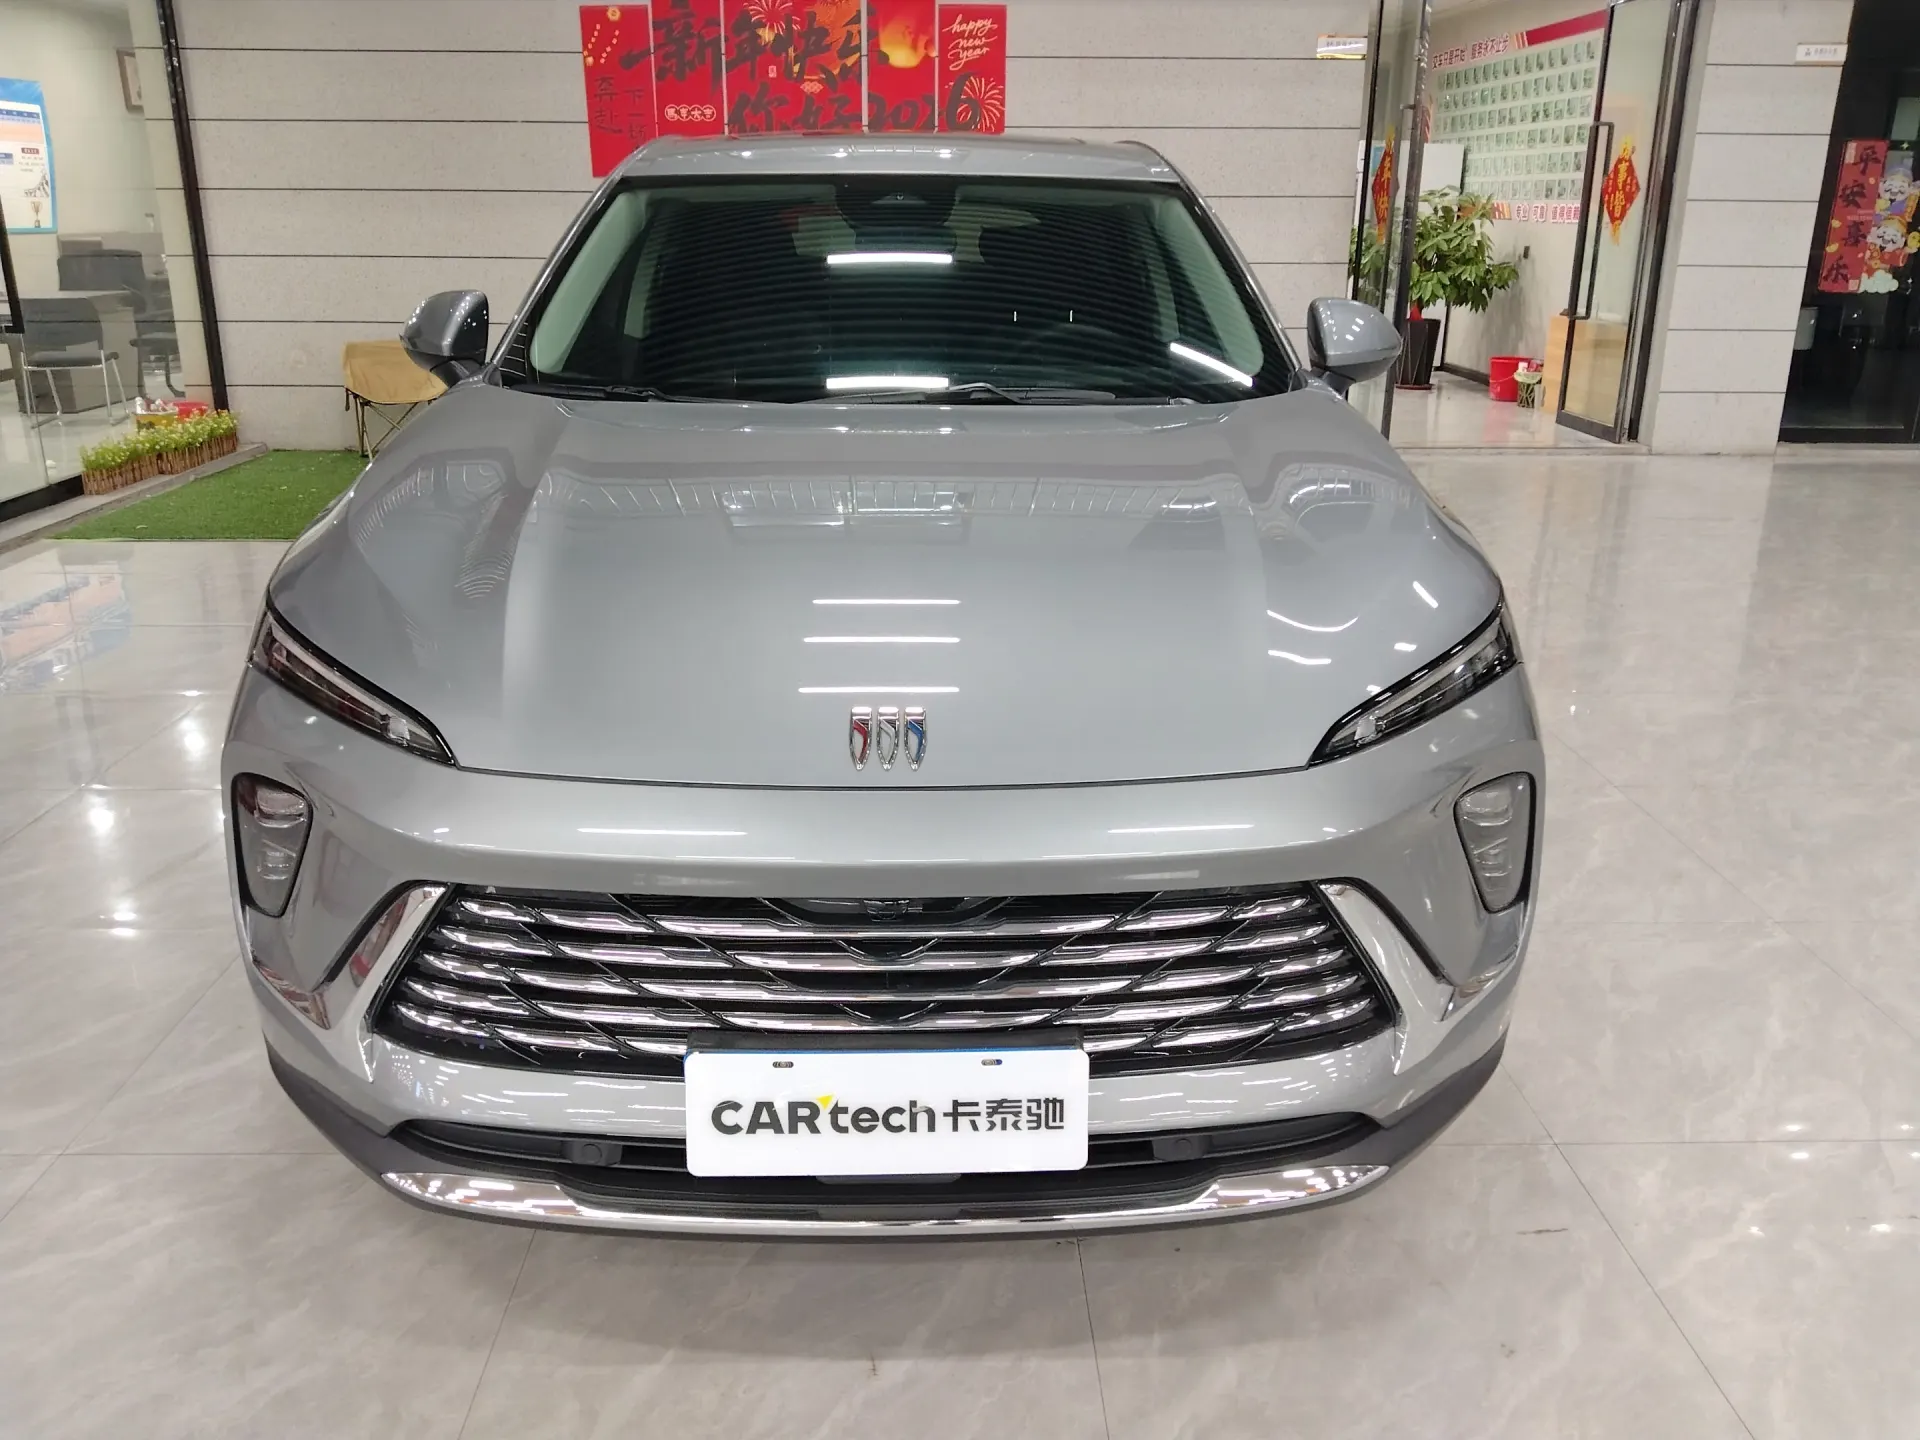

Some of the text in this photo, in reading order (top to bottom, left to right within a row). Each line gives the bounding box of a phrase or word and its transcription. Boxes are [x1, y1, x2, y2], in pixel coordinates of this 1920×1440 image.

[942, 14, 998, 37] happy
[619, 0, 889, 98] 新年快乐
[948, 36, 998, 50] new
[1432, 33, 1509, 69] 交车只是开始 服务永不止步
[948, 48, 990, 71] year
[1516, 204, 1529, 220] 专业
[1823, 145, 1882, 283] 平安喜乐
[711, 1097, 1065, 1136] CARtech 卡泰驰
